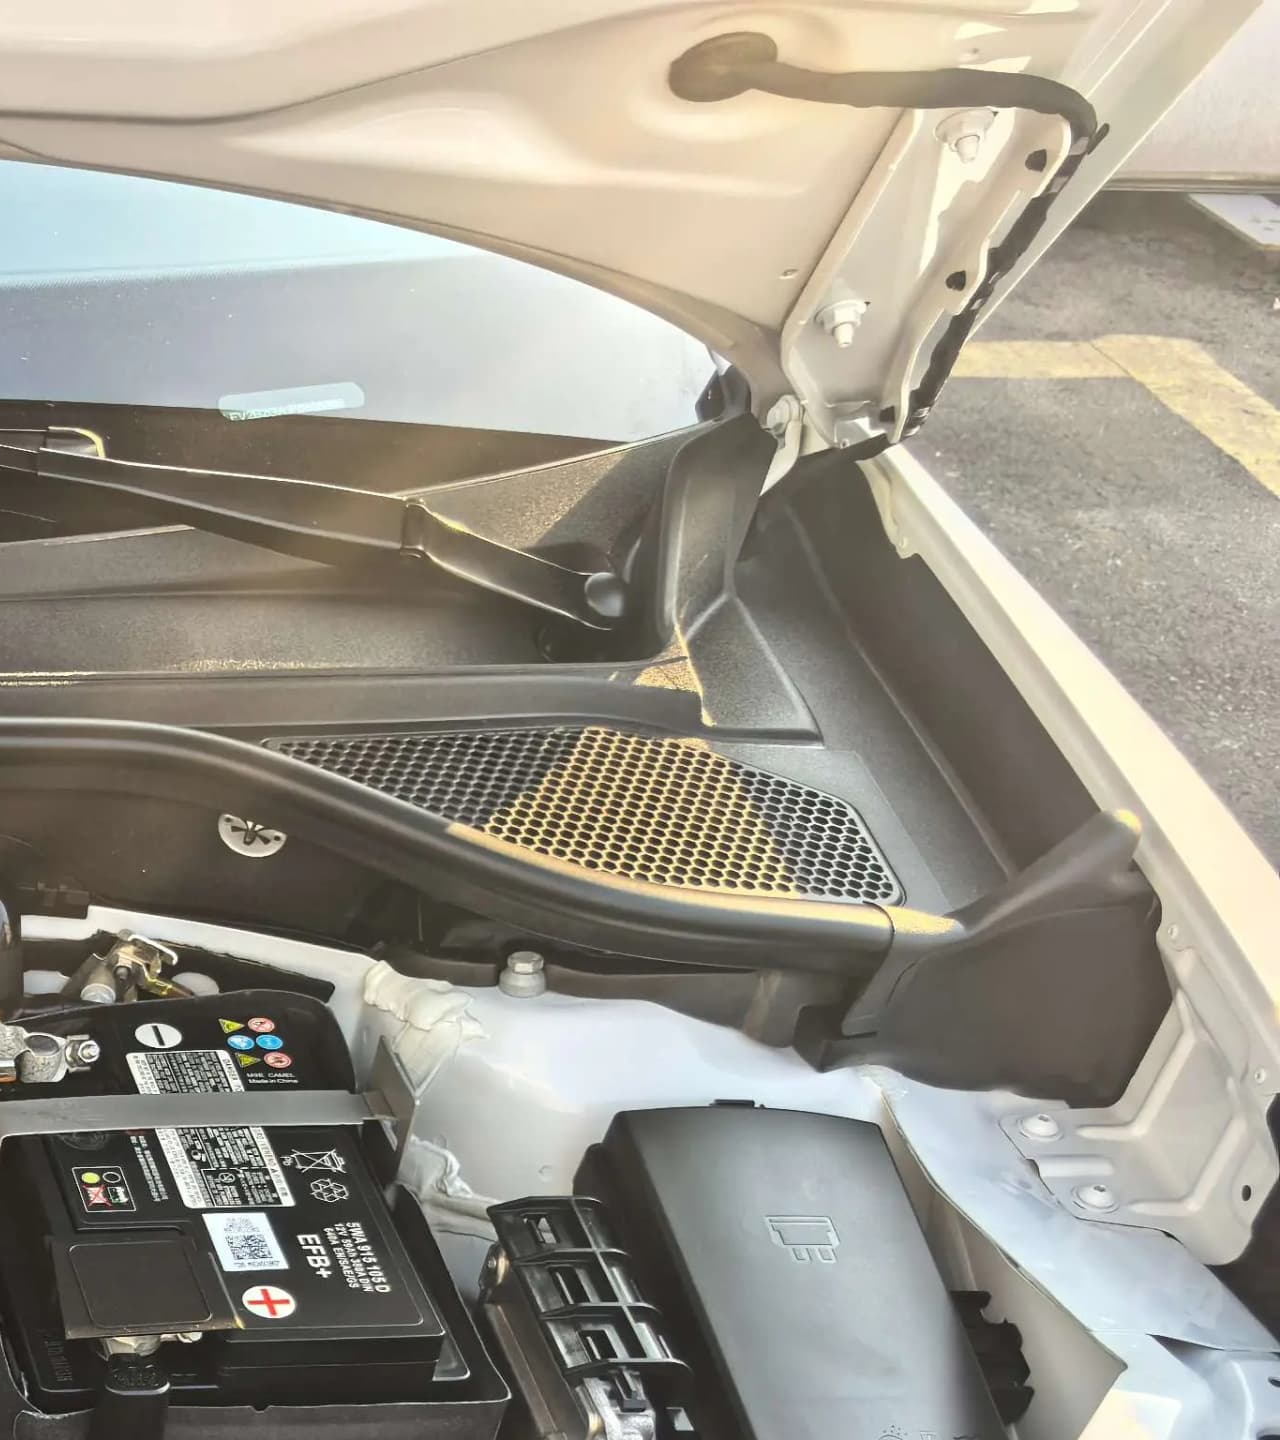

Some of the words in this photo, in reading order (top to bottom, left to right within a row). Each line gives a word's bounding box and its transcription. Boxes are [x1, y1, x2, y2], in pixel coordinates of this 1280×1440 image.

[334, 1223, 348, 1236] 12V
[346, 1222, 368, 1244] 5WA
[296, 1234, 332, 1278] EFB+
[356, 1245, 378, 1263] 915
[366, 1265, 387, 1283] 105
[374, 1285, 392, 1293] D
